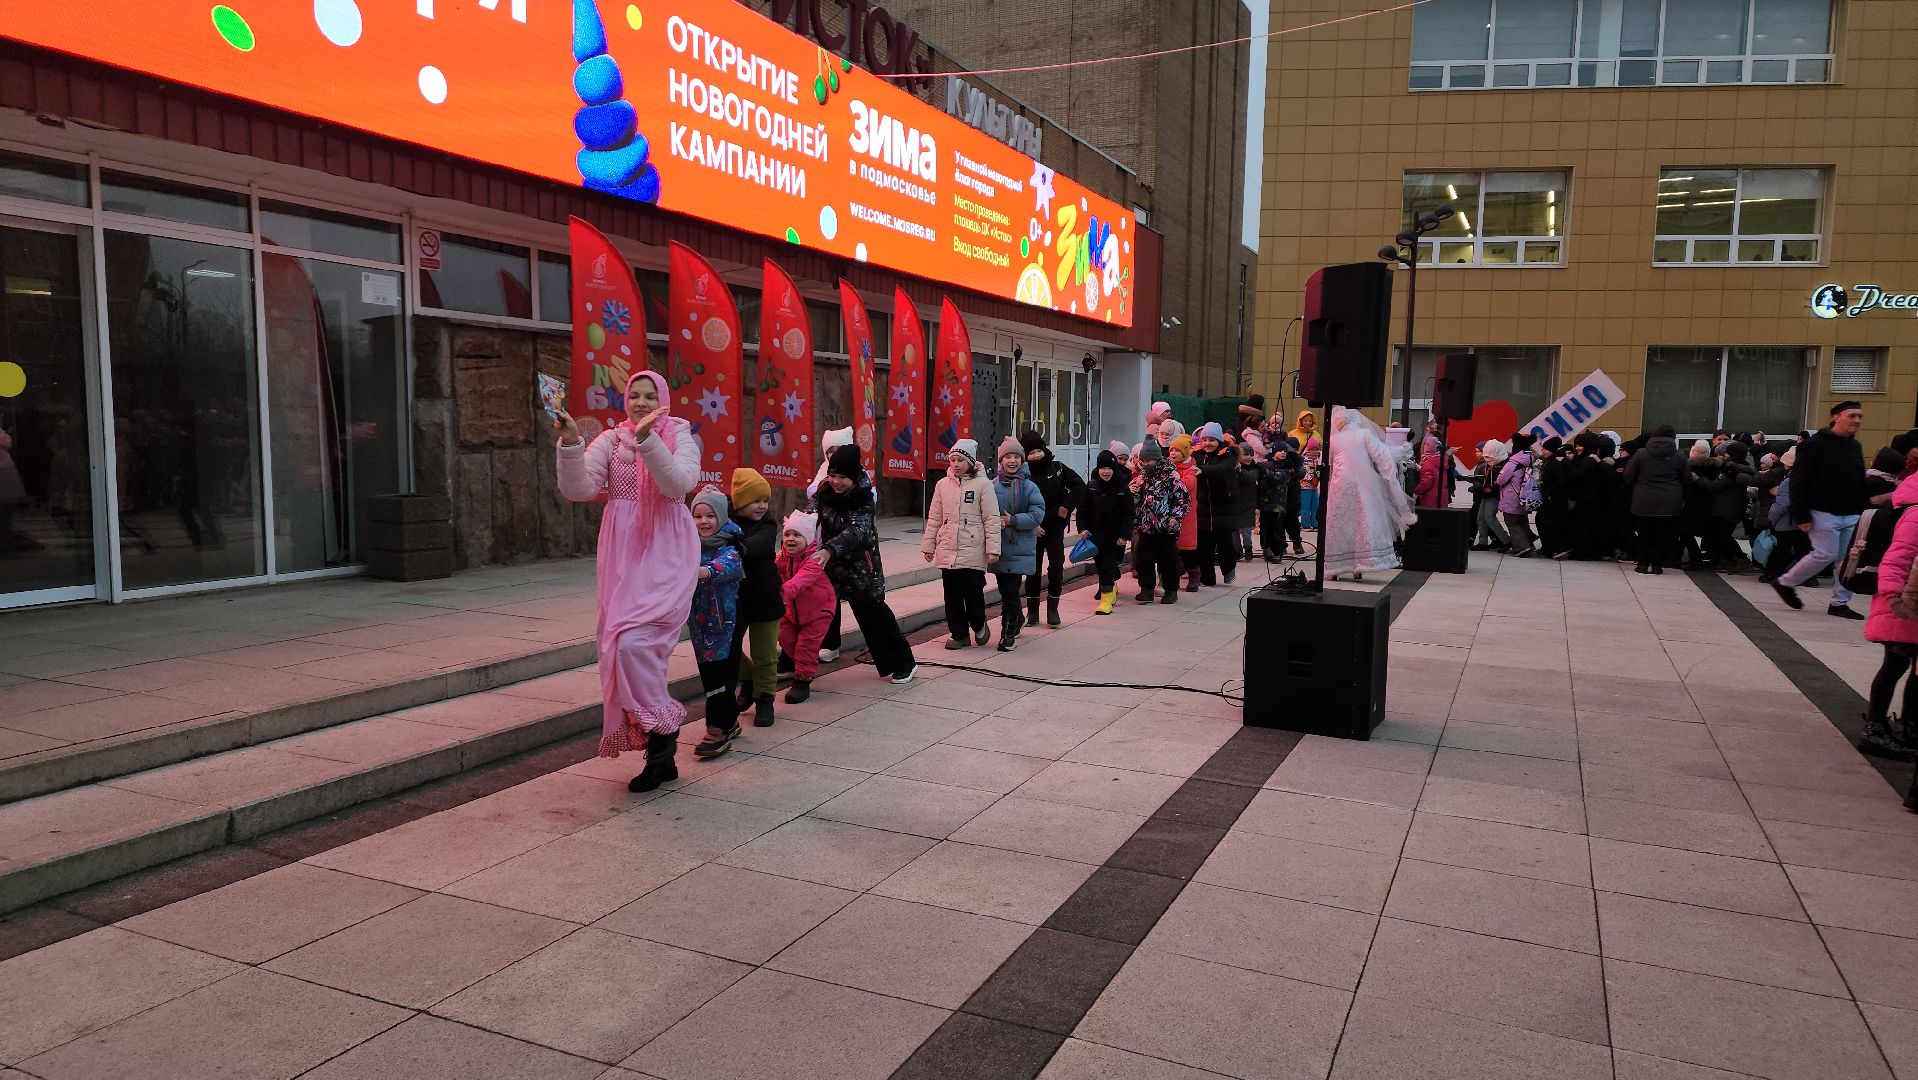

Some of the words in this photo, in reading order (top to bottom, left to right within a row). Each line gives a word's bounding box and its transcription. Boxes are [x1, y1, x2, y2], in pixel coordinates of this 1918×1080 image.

[667, 15, 799, 105] ОТКРЫТИЕ
[669, 67, 828, 163] НОВОГОДНЕЙ
[670, 121, 806, 199] КАМПАНИИ
[954, 193, 974, 212] Место
[971, 178, 995, 198] города
[850, 201, 936, 242] WELCOME.MOSREG.RU
[1030, 217, 1042, 241] 0+
[953, 235, 972, 258] Вход
[972, 245, 1010, 268] свободный
